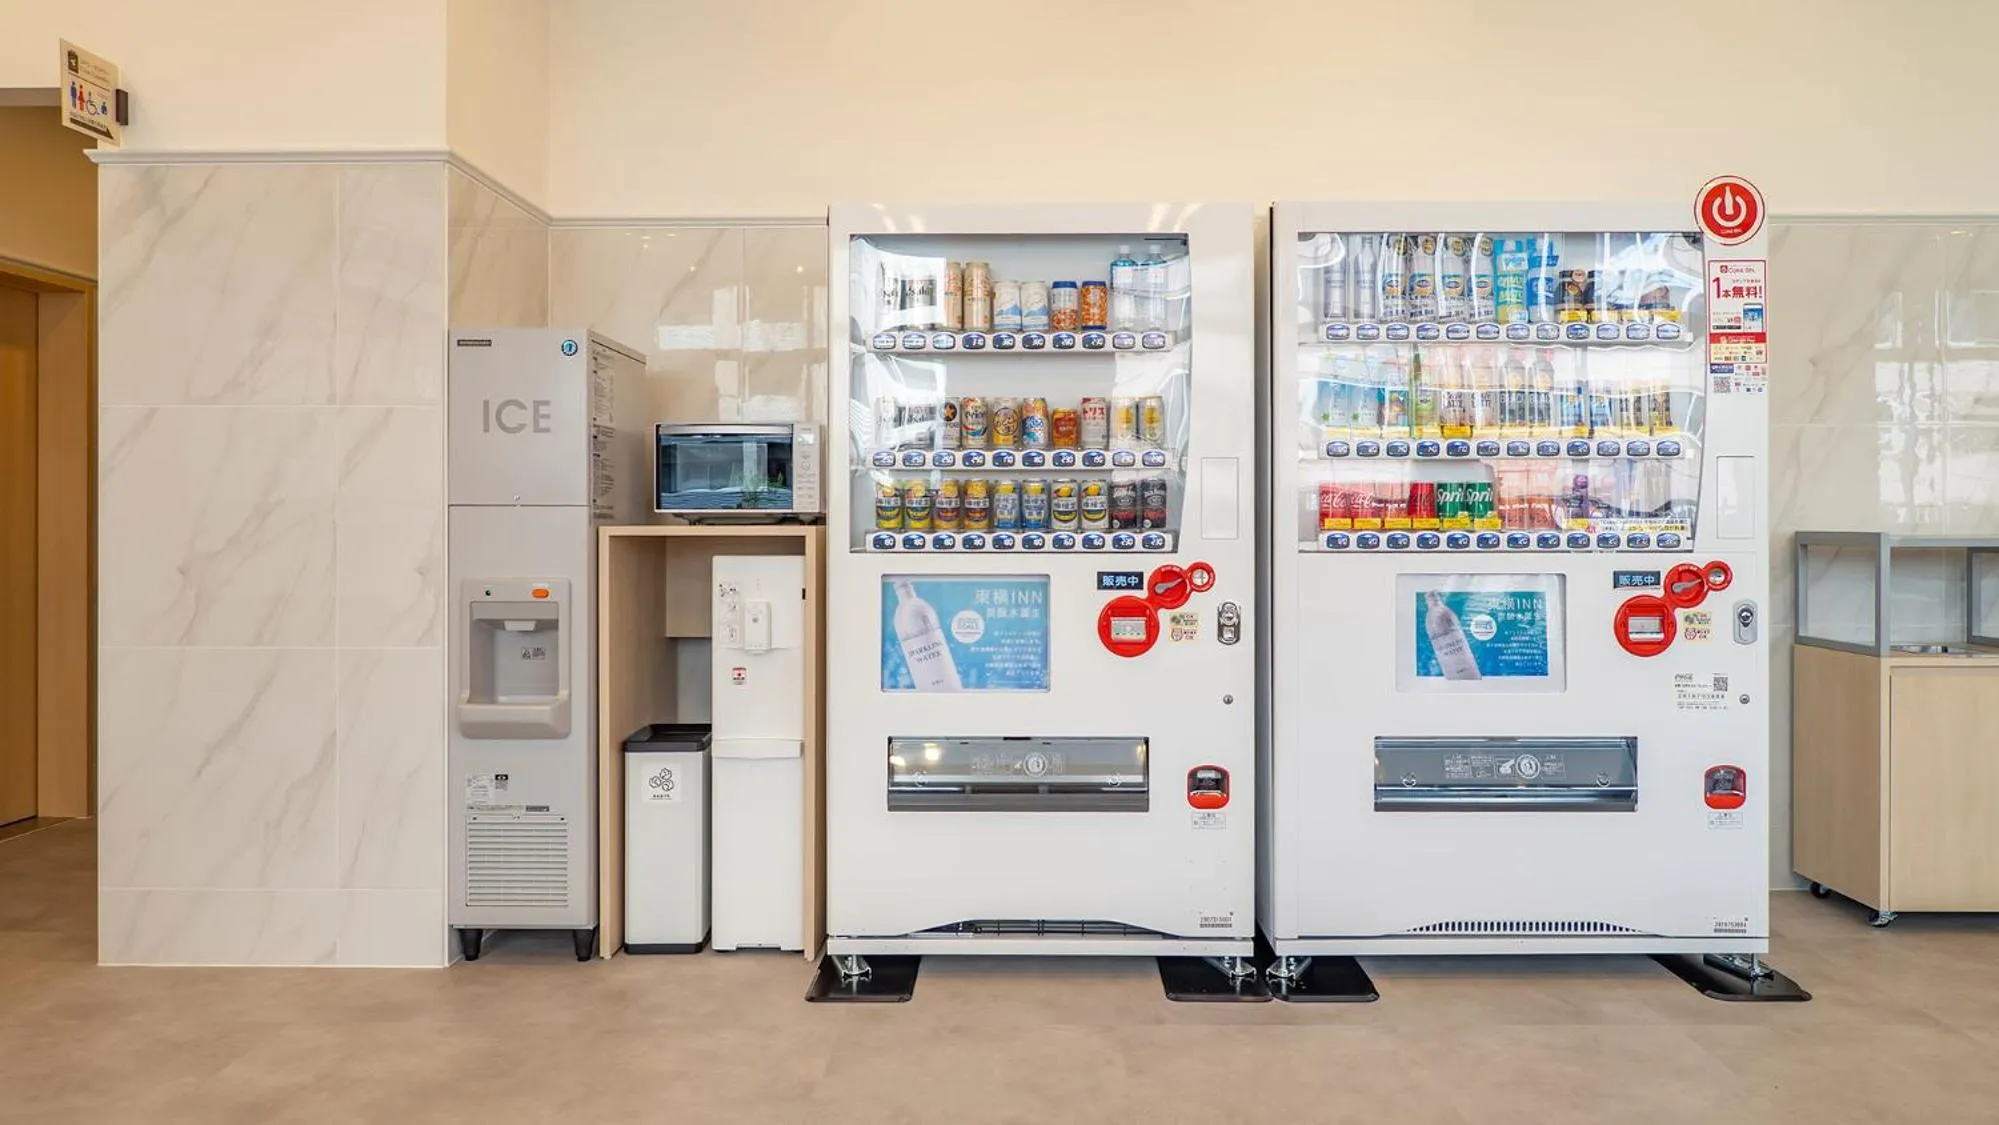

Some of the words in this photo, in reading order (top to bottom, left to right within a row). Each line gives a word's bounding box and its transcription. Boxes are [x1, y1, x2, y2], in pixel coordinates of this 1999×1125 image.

[483, 399, 552, 434] ICE
[1102, 575, 1139, 586] 販売中
[1618, 575, 1655, 586] 販売中
